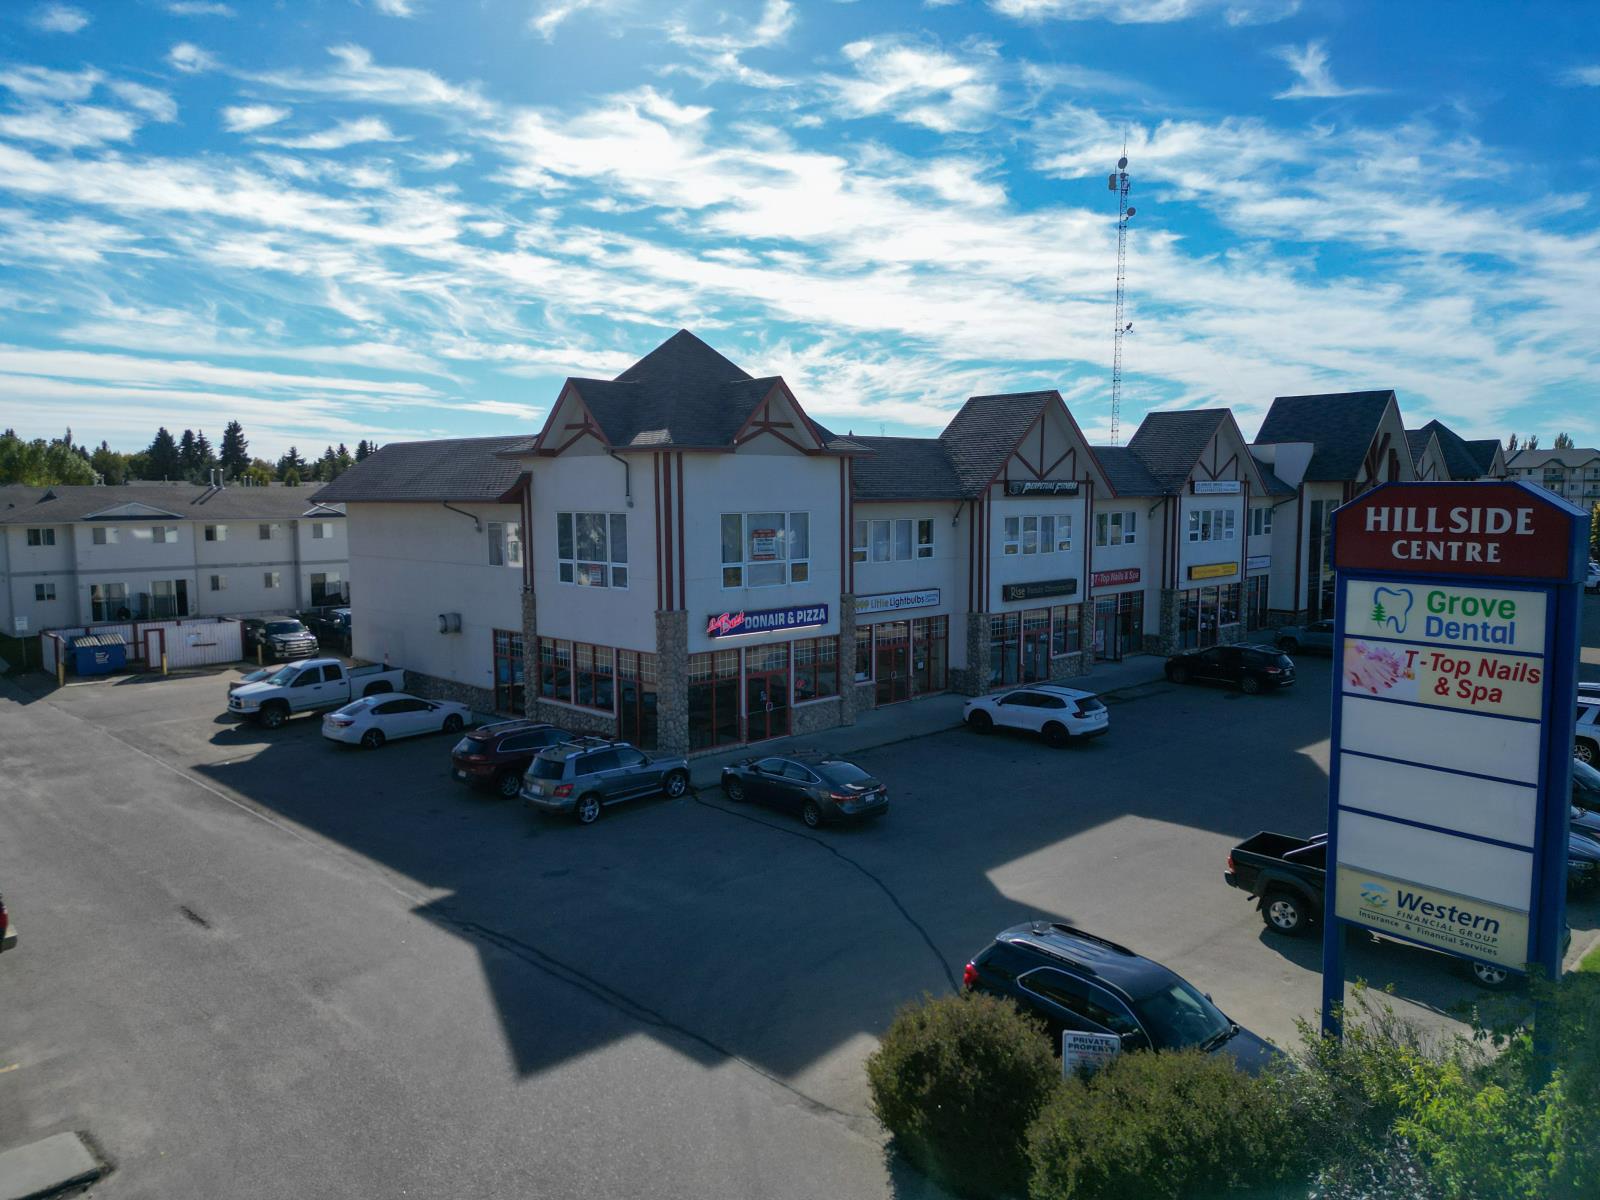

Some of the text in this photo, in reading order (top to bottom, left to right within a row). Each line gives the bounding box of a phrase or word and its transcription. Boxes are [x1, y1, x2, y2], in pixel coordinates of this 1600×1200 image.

[1365, 507, 1535, 535] HILLSIDE
[1391, 539, 1501, 563] CENTRE
[889, 594, 925, 608] Lightbulbs
[1426, 590, 1516, 619] Grove
[745, 613, 785, 629] DONAIR
[788, 611, 795, 624] &
[797, 608, 826, 623] PIZZA
[1425, 615, 1515, 645] Dental
[1478, 659, 1541, 684] Nails
[1434, 677, 1503, 704] & Spa
[1397, 890, 1500, 934] Western
[1359, 909, 1399, 928] Insurance
[1416, 926, 1457, 945] Financial
[1460, 938, 1498, 956] Services
[1396, 910, 1498, 944] FINANCIAL GROUP
[1068, 1043, 1115, 1053] PROPERTY
[1073, 1037, 1110, 1046] PRIVATE
